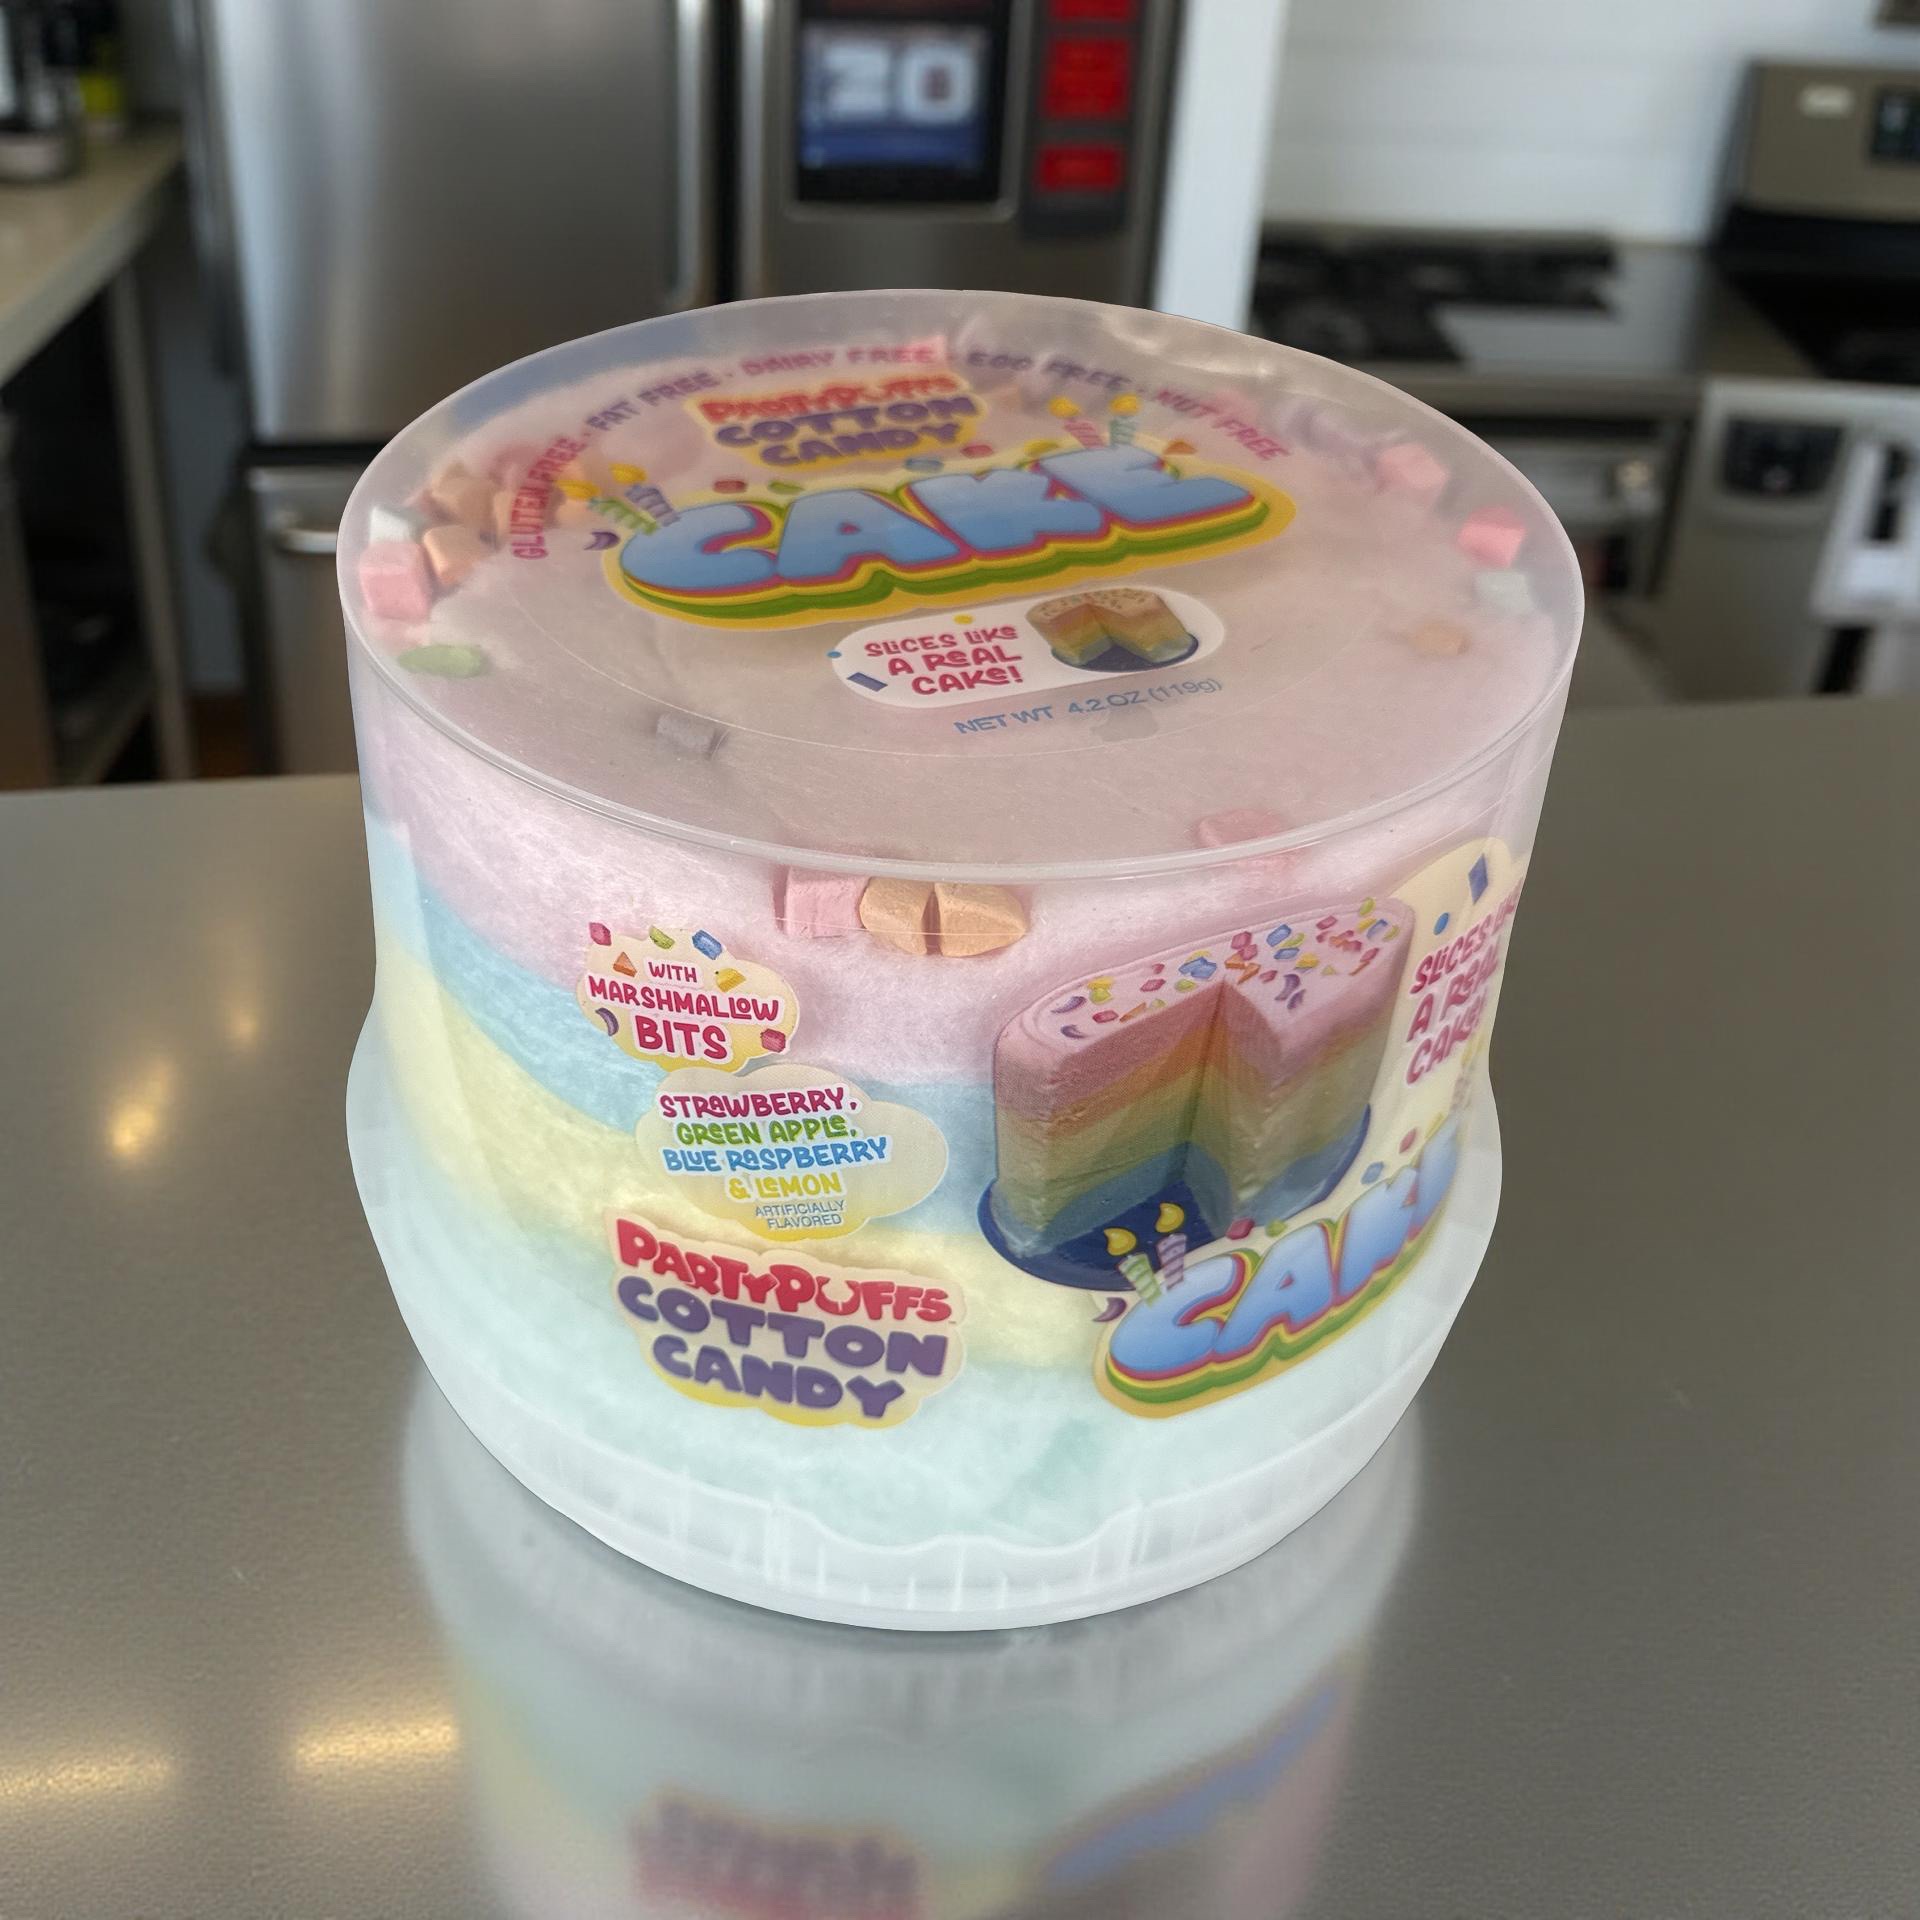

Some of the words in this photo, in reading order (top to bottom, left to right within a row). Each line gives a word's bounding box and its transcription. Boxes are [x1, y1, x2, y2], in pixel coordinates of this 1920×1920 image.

[741, 350, 835, 375] DAIRY
[846, 346, 937, 364] FREE
[637, 371, 721, 407] FREE
[1154, 389, 1220, 418] NUT
[586, 400, 640, 431] FAT
[715, 396, 977, 447] COTTON
[760, 422, 960, 466] CANDY
[1212, 418, 1291, 460] FREE
[528, 436, 589, 483] FREE
[510, 486, 550, 560] GLUTEN
[618, 444, 1258, 604] CAKE
[863, 633, 958, 658] SLICES
[965, 625, 1019, 644] LIKE
[887, 656, 915, 677] A
[922, 644, 1022, 673] REAL
[911, 666, 1025, 697] CAKE!
[953, 714, 1008, 735] NET
[1009, 706, 1055, 725] WT
[1067, 699, 1106, 715] 4.2
[1106, 690, 1148, 708] OZ
[1148, 677, 1223, 703] (119g)
[648, 960, 698, 983] WITH
[588, 975, 779, 1021] MARSHMALLOW
[1406, 993, 1434, 1043] A
[635, 1014, 728, 1060] BITS
[659, 1086, 858, 1119] STRAWBERRY,
[676, 1120, 761, 1146] GREEN
[769, 1114, 857, 1143] APPLE,
[663, 1149, 718, 1172] BLUE
[729, 1136, 888, 1172] RASPBERRY
[728, 1178, 750, 1199] &
[758, 1171, 842, 1198] LEMON
[755, 1200, 845, 1217] ARTIFICIALLY
[767, 1213, 843, 1229] FLAVORED
[616, 1218, 953, 1323] PARTYPUFFS
[617, 1275, 949, 1377] COTTON
[652, 1334, 906, 1419] CANDY
